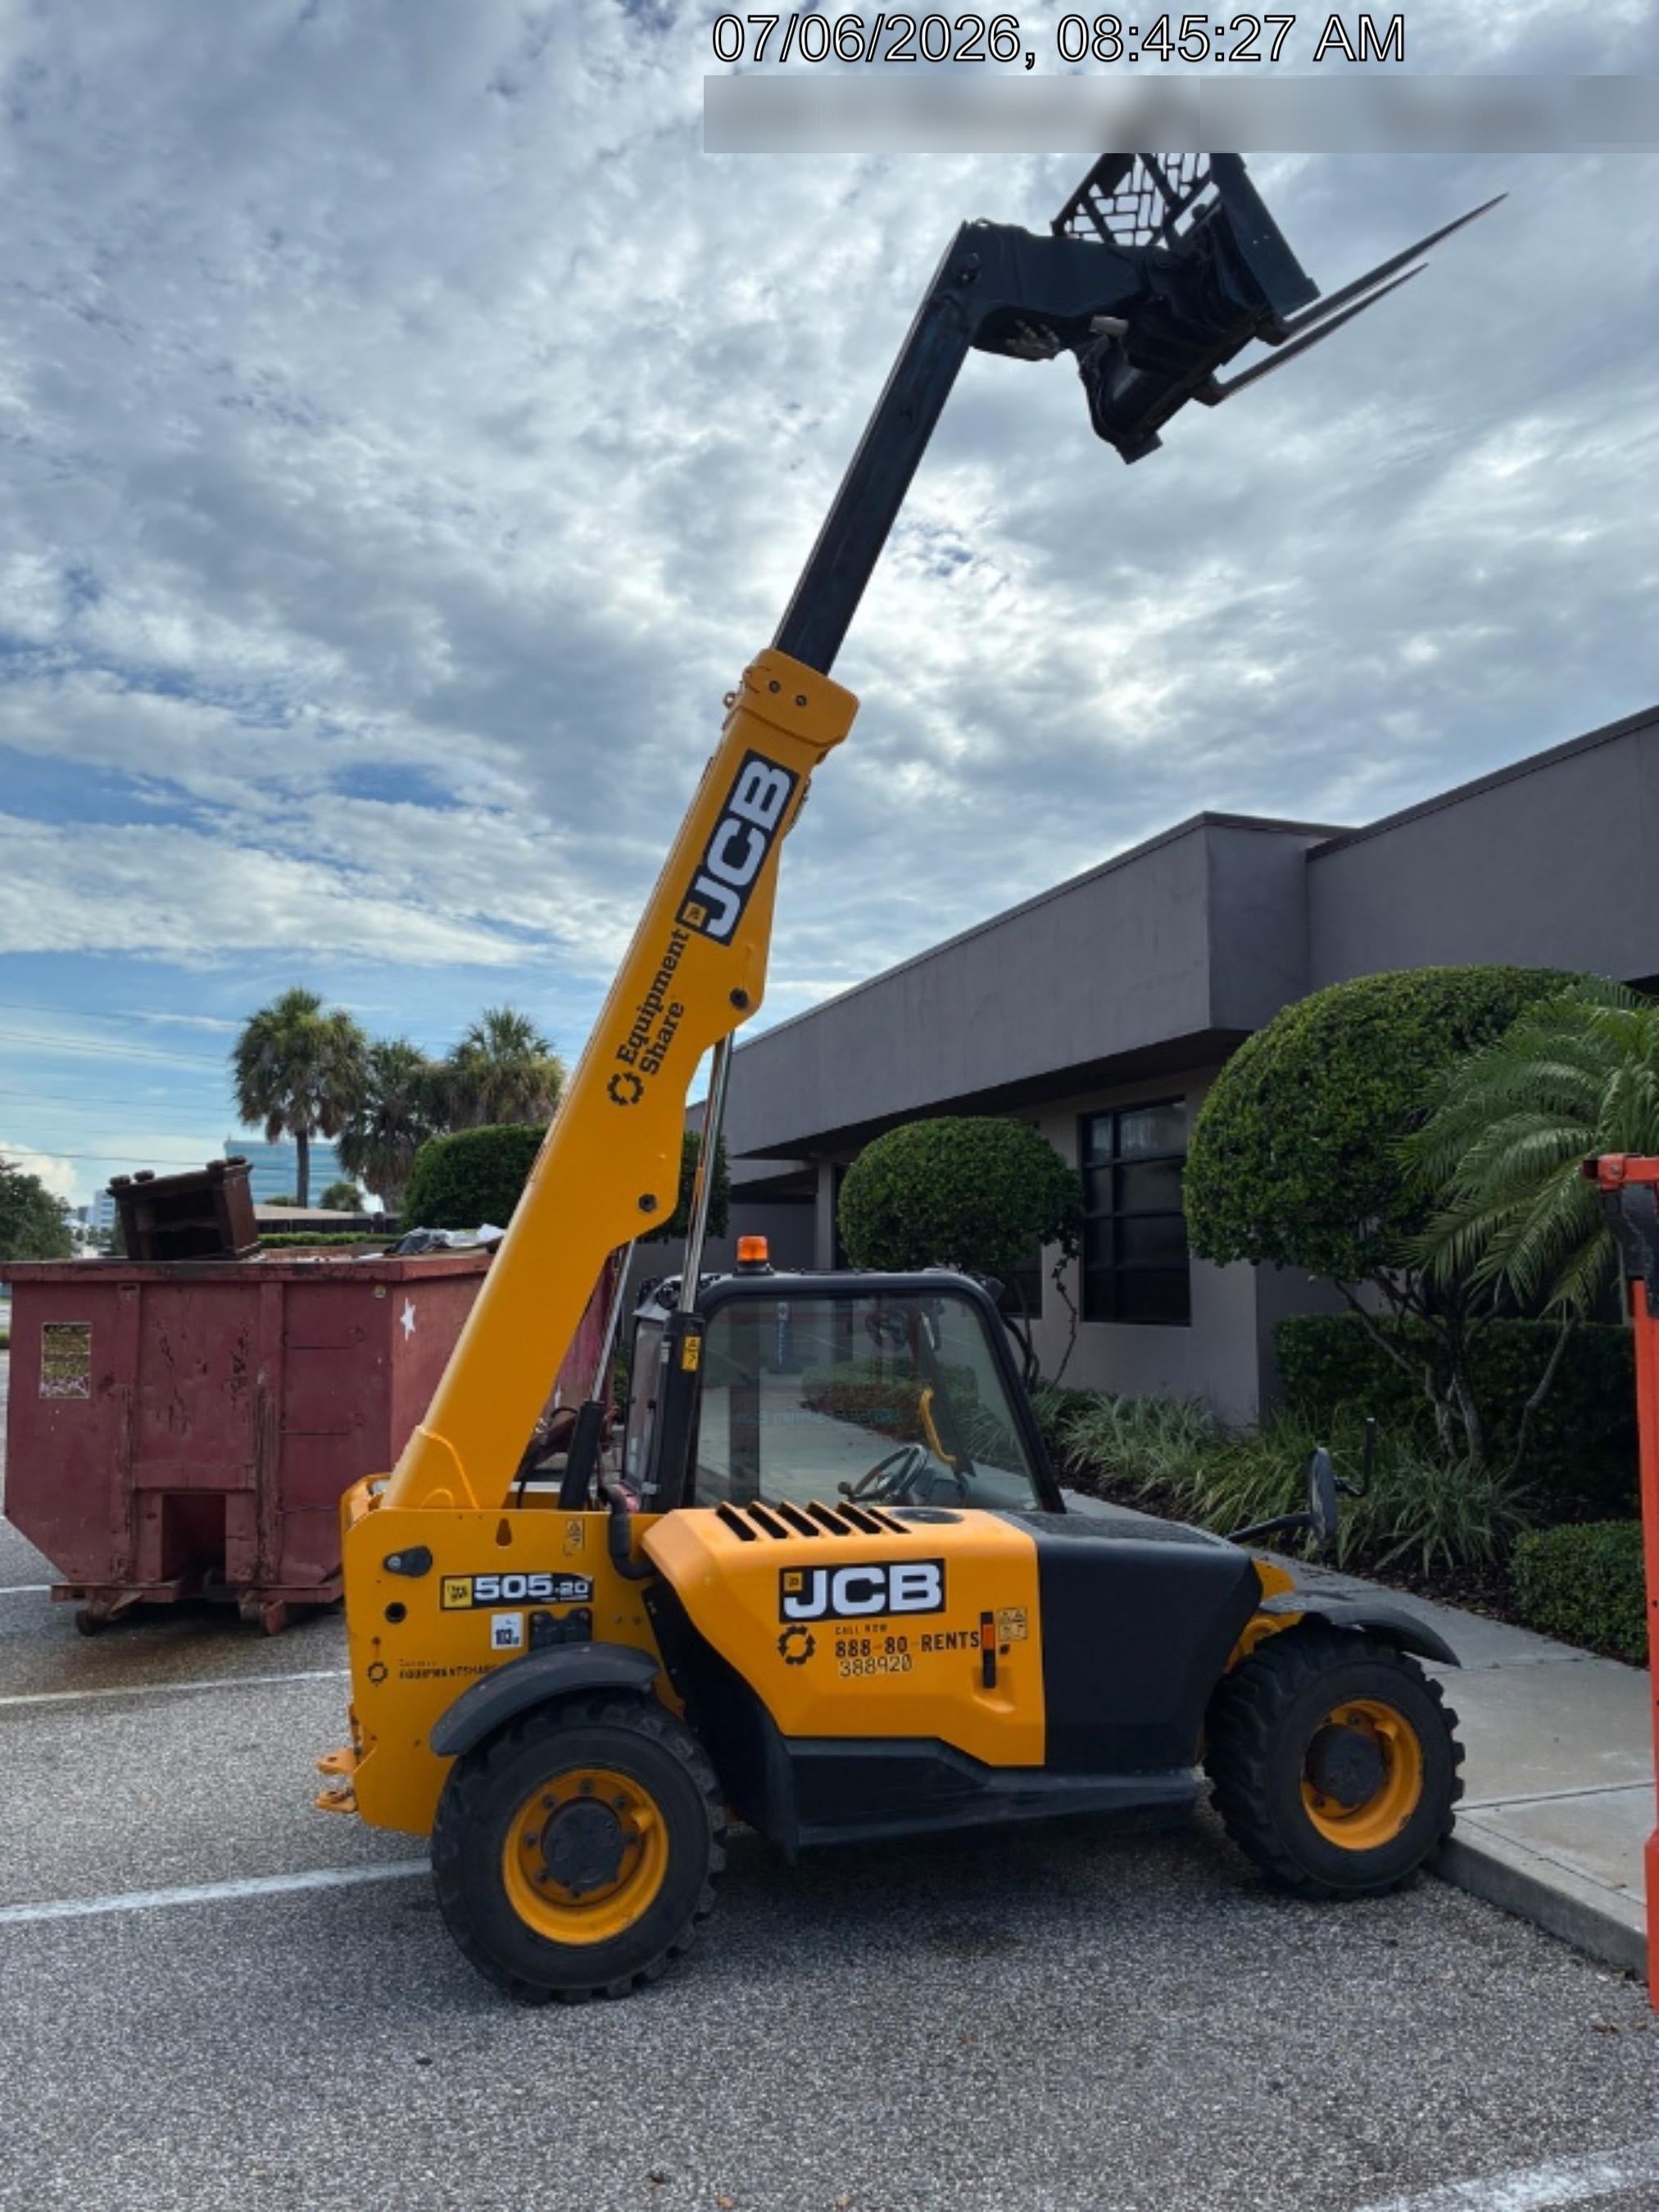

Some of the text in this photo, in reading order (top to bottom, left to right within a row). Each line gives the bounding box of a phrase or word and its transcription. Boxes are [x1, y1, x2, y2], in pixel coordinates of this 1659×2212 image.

[695, 757, 792, 937] JCB
[616, 928, 690, 1066] Equipment
[638, 1001, 685, 1075] Share
[783, 1563, 942, 1619] JCB
[839, 1654, 913, 1677] 388920
